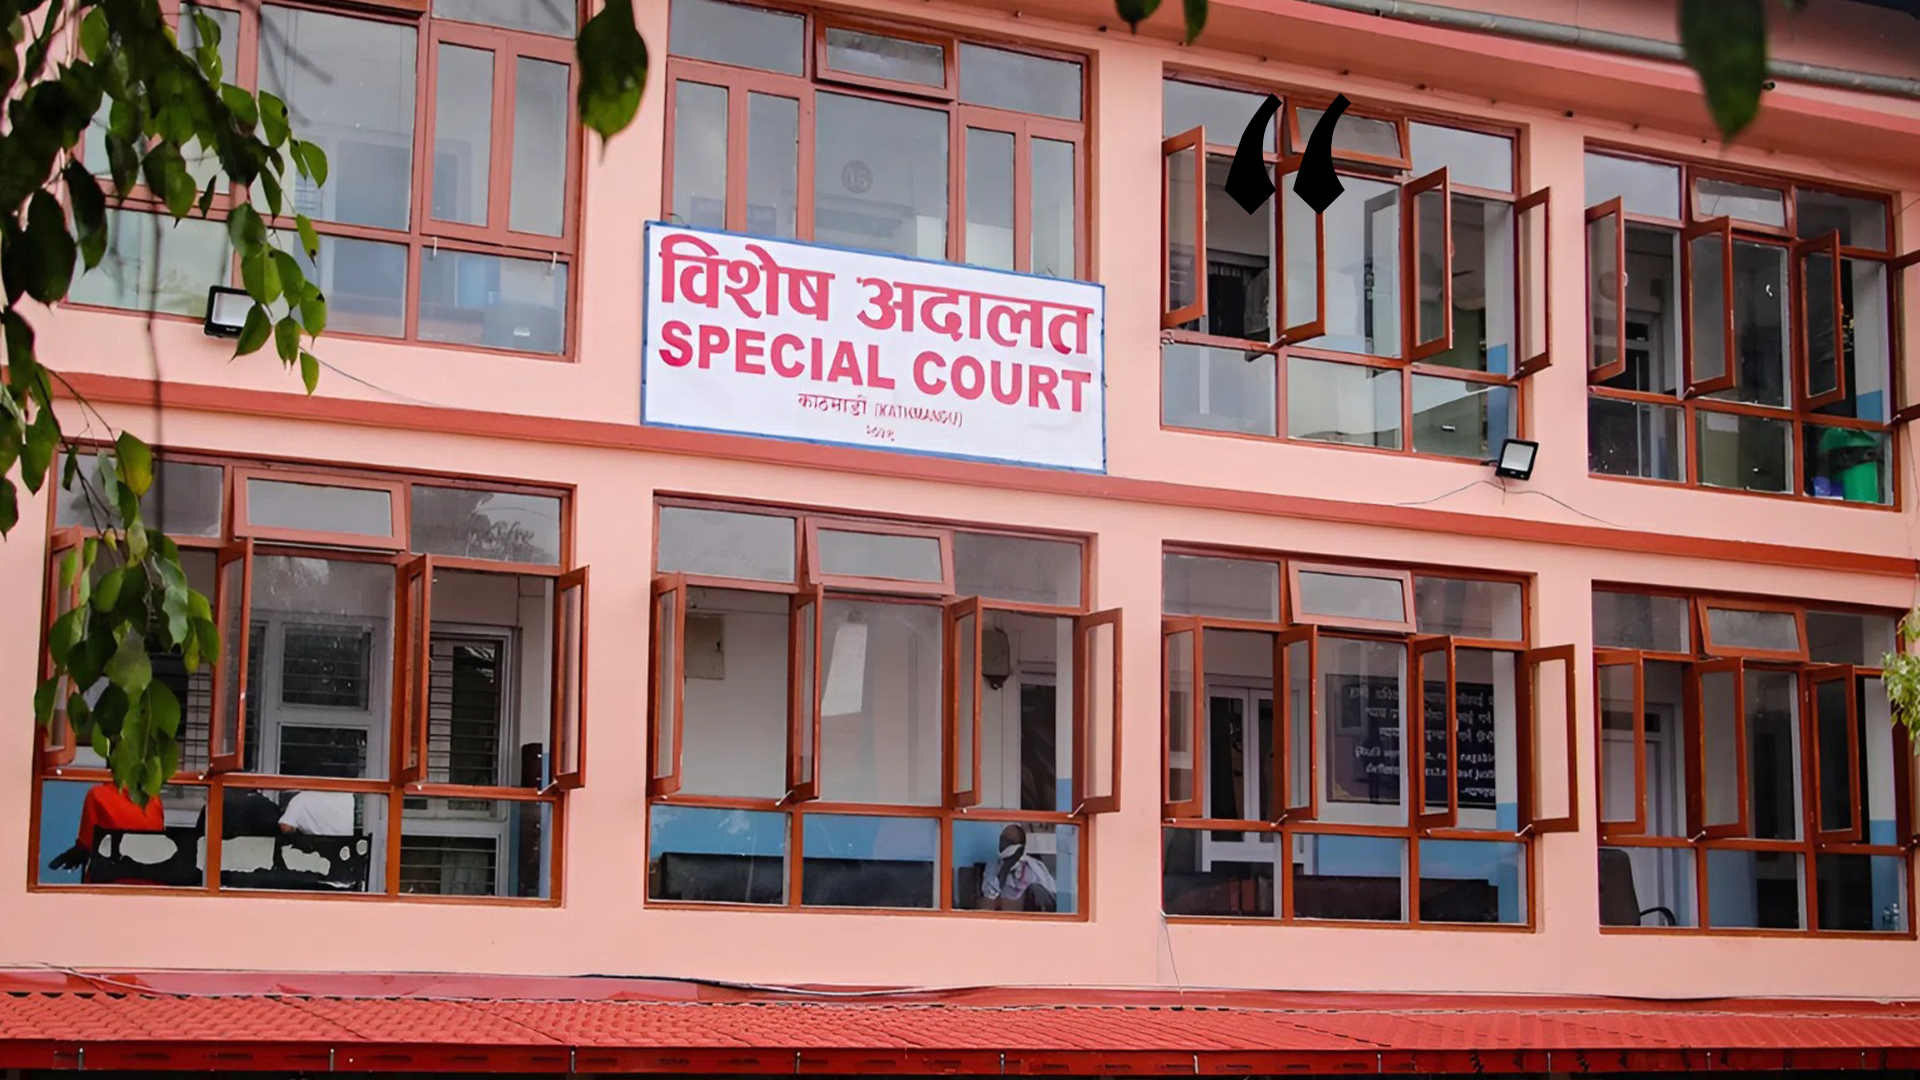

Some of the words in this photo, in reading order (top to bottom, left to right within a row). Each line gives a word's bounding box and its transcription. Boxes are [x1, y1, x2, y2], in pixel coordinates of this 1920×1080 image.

[659, 233, 836, 322] विशेष
[856, 277, 1095, 355] अदालत
[659, 320, 896, 390] SPECIAL
[912, 350, 1092, 413] COURT
